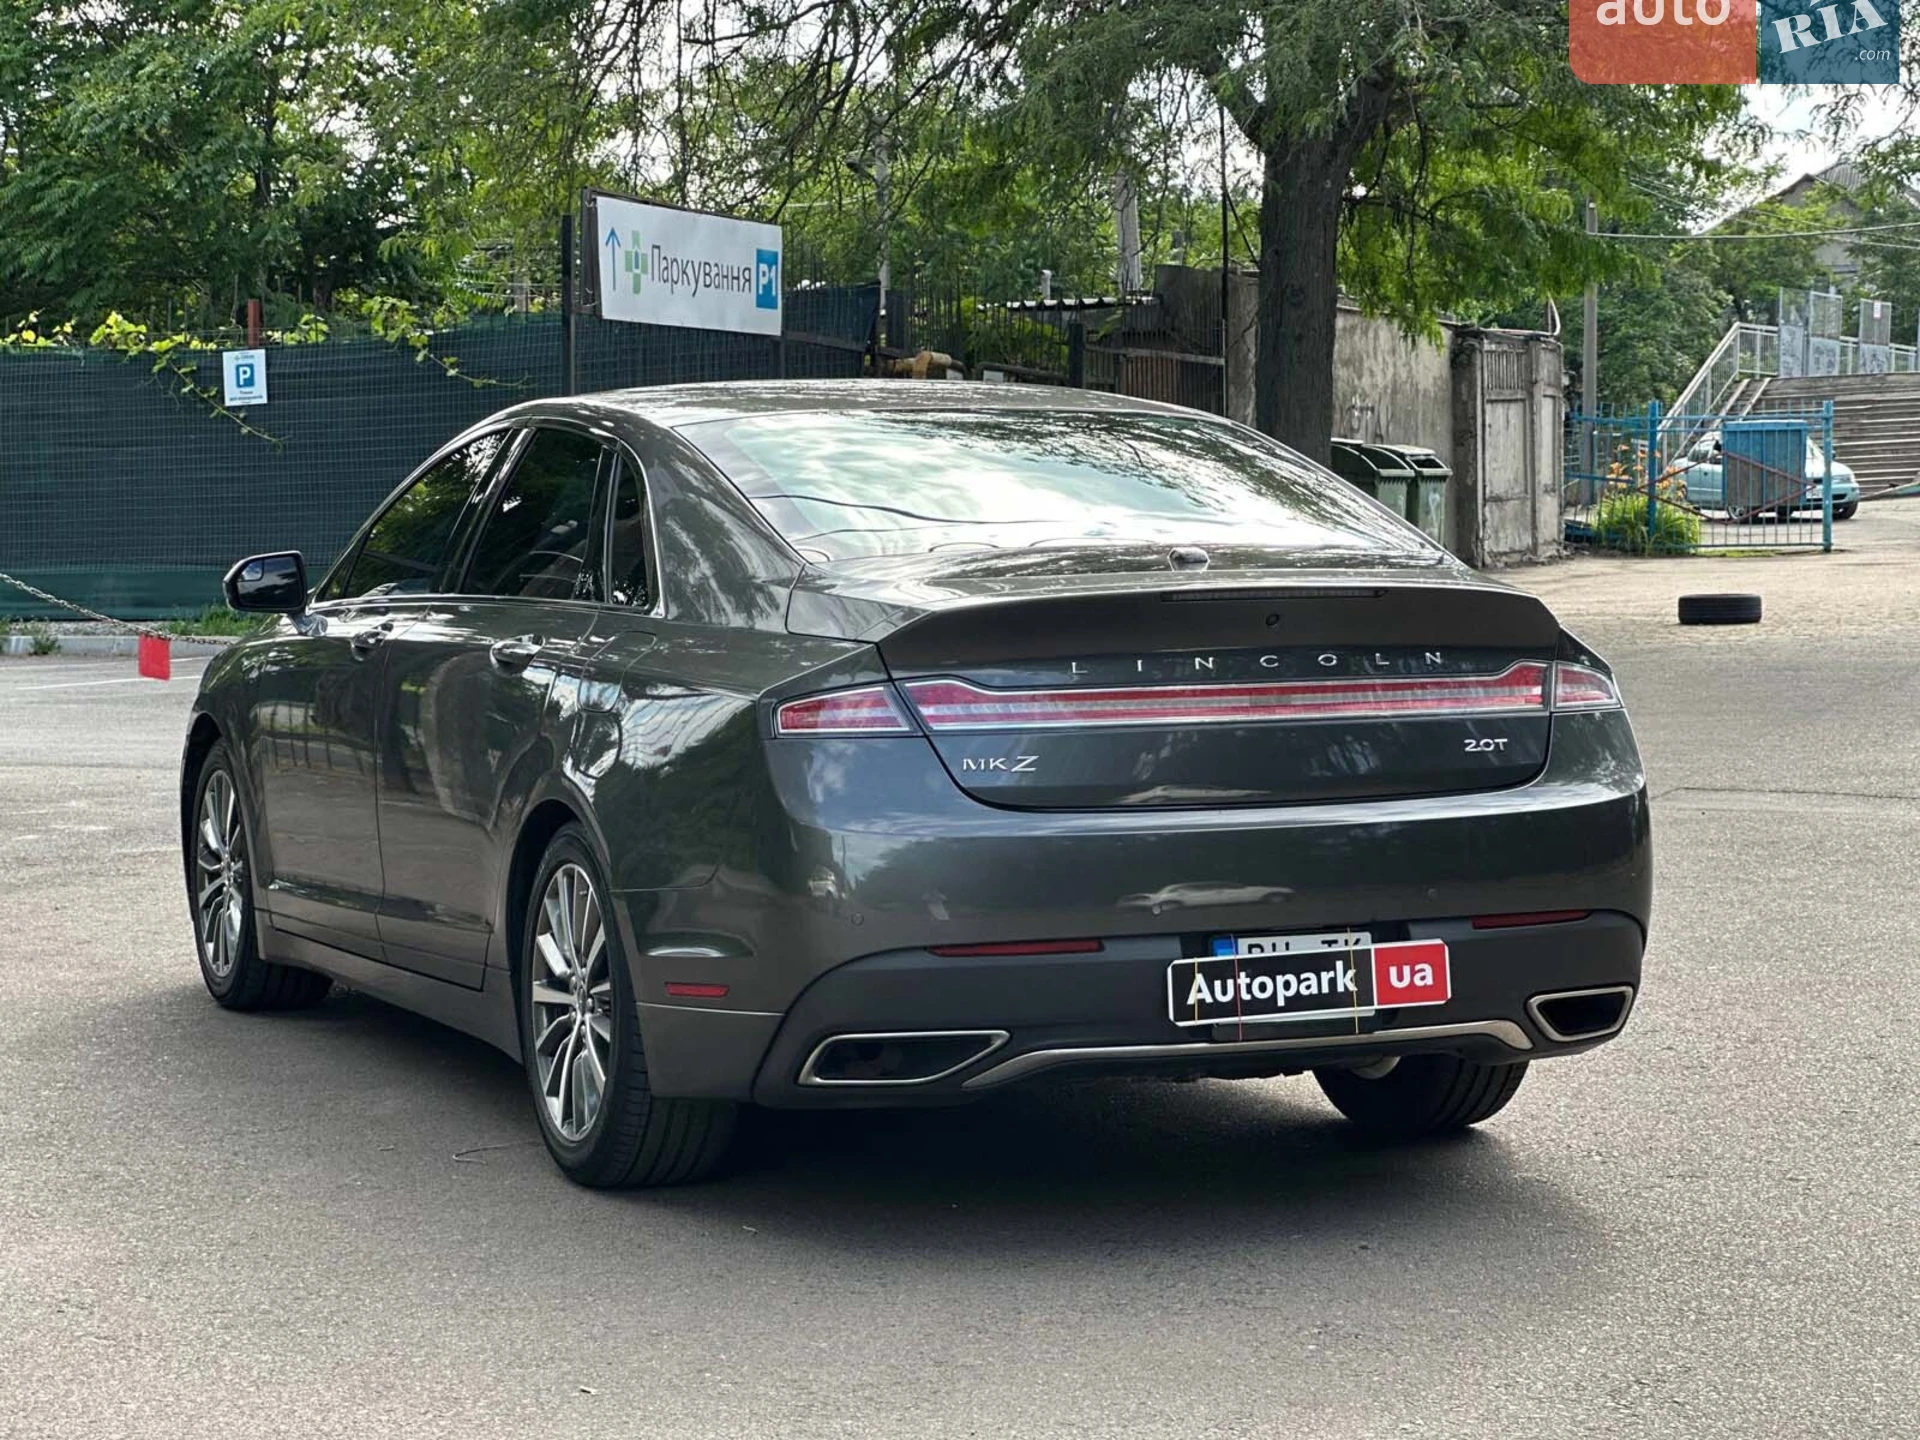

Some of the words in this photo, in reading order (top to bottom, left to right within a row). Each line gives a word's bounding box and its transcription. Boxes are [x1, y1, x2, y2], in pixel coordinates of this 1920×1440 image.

[651, 243, 752, 298] Паркування
[238, 365, 252, 386] P
[1071, 651, 1442, 675] LINCOLN
[962, 755, 1040, 773] MKZ
[1186, 960, 1359, 1007] Autopark
[1389, 962, 1434, 989] ua
